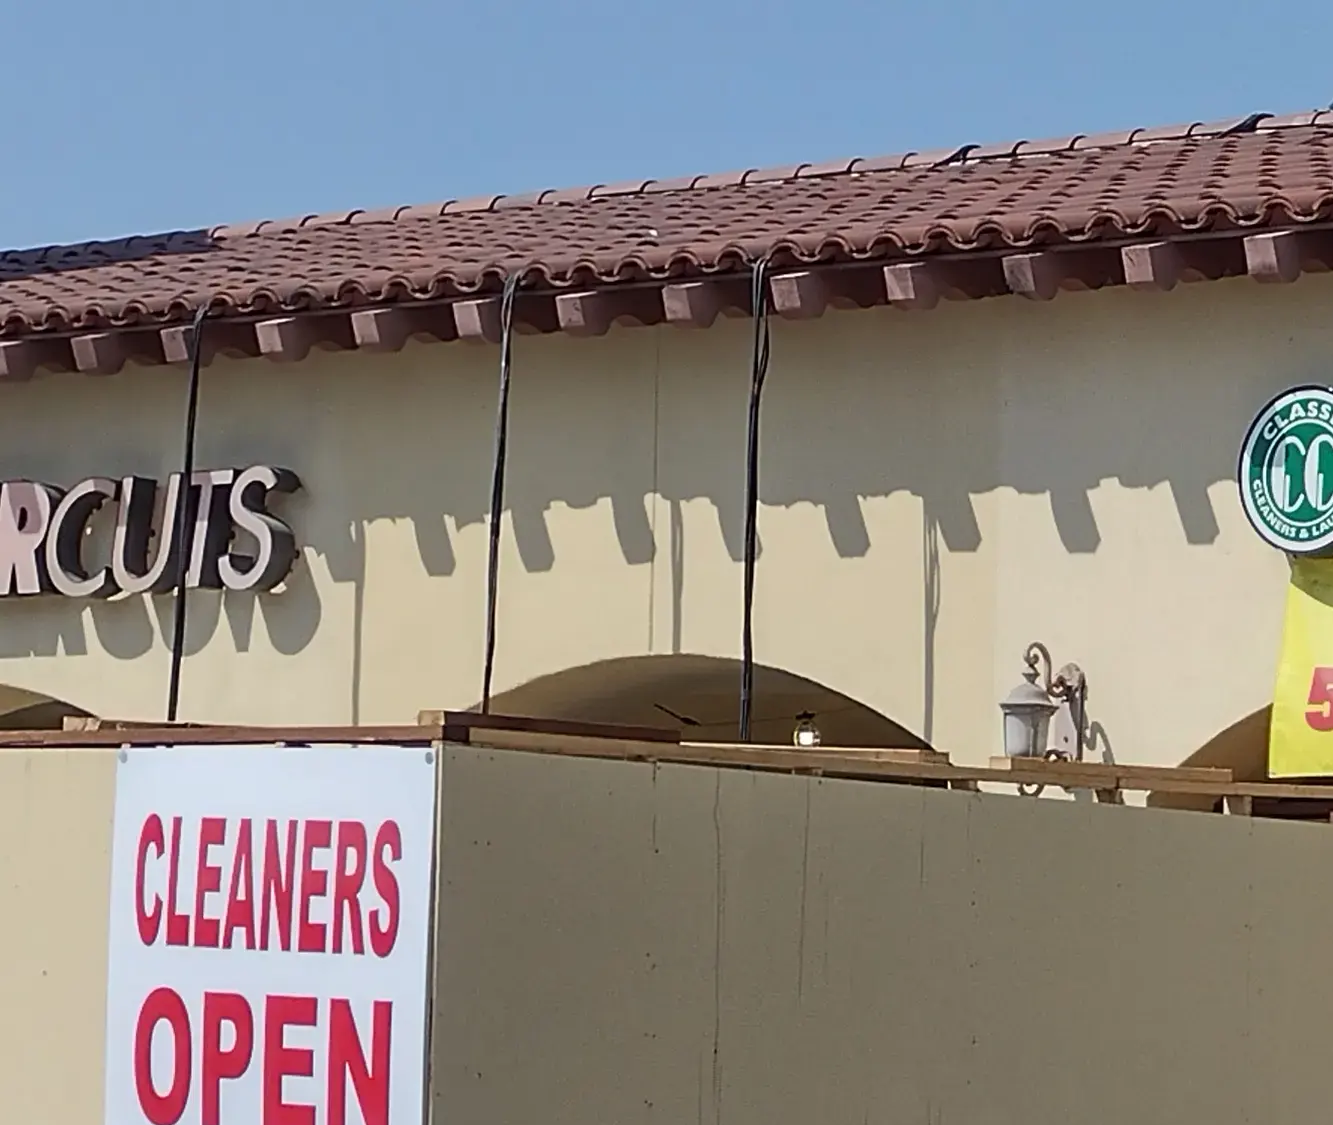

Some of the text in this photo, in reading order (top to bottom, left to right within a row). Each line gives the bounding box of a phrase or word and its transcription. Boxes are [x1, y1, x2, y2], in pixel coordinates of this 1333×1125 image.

[1252, 479, 1297, 538] CLEANERS
[1298, 526, 1310, 539] &
[134, 812, 403, 959] CLEANERS
